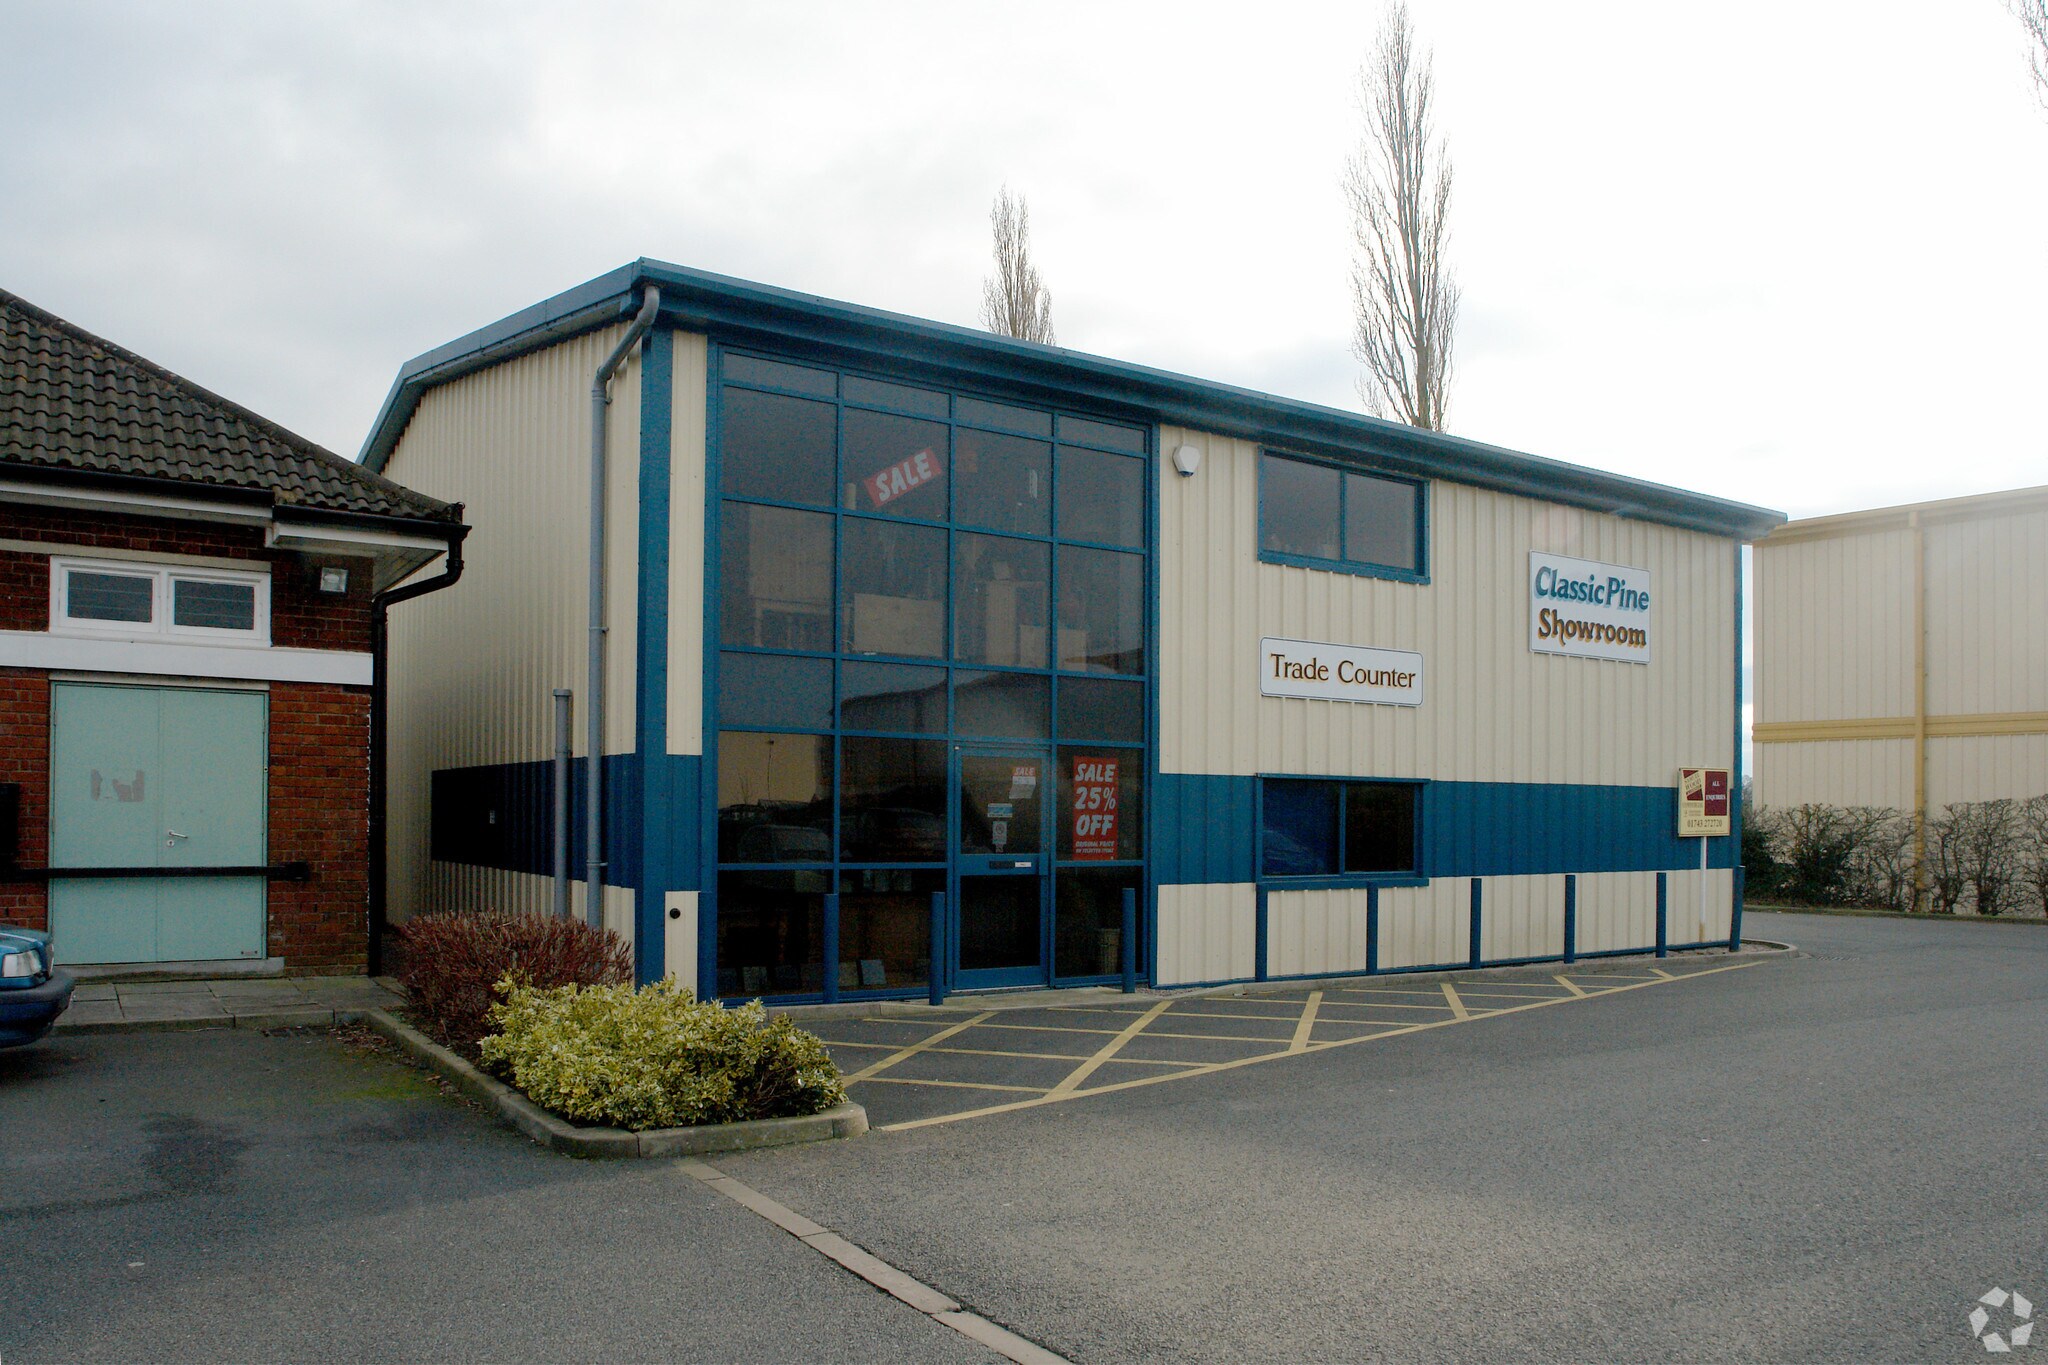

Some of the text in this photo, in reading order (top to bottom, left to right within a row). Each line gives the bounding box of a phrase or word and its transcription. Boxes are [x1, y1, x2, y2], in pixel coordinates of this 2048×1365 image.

[876, 452, 931, 501] SALE
[1538, 608, 1646, 647] Showroom
[1270, 653, 1416, 688] Trade Counter
[1014, 767, 1035, 776] SALE
[1075, 764, 1116, 782] SALE
[1075, 786, 1116, 811] 25%
[1076, 814, 1114, 836] OFF
